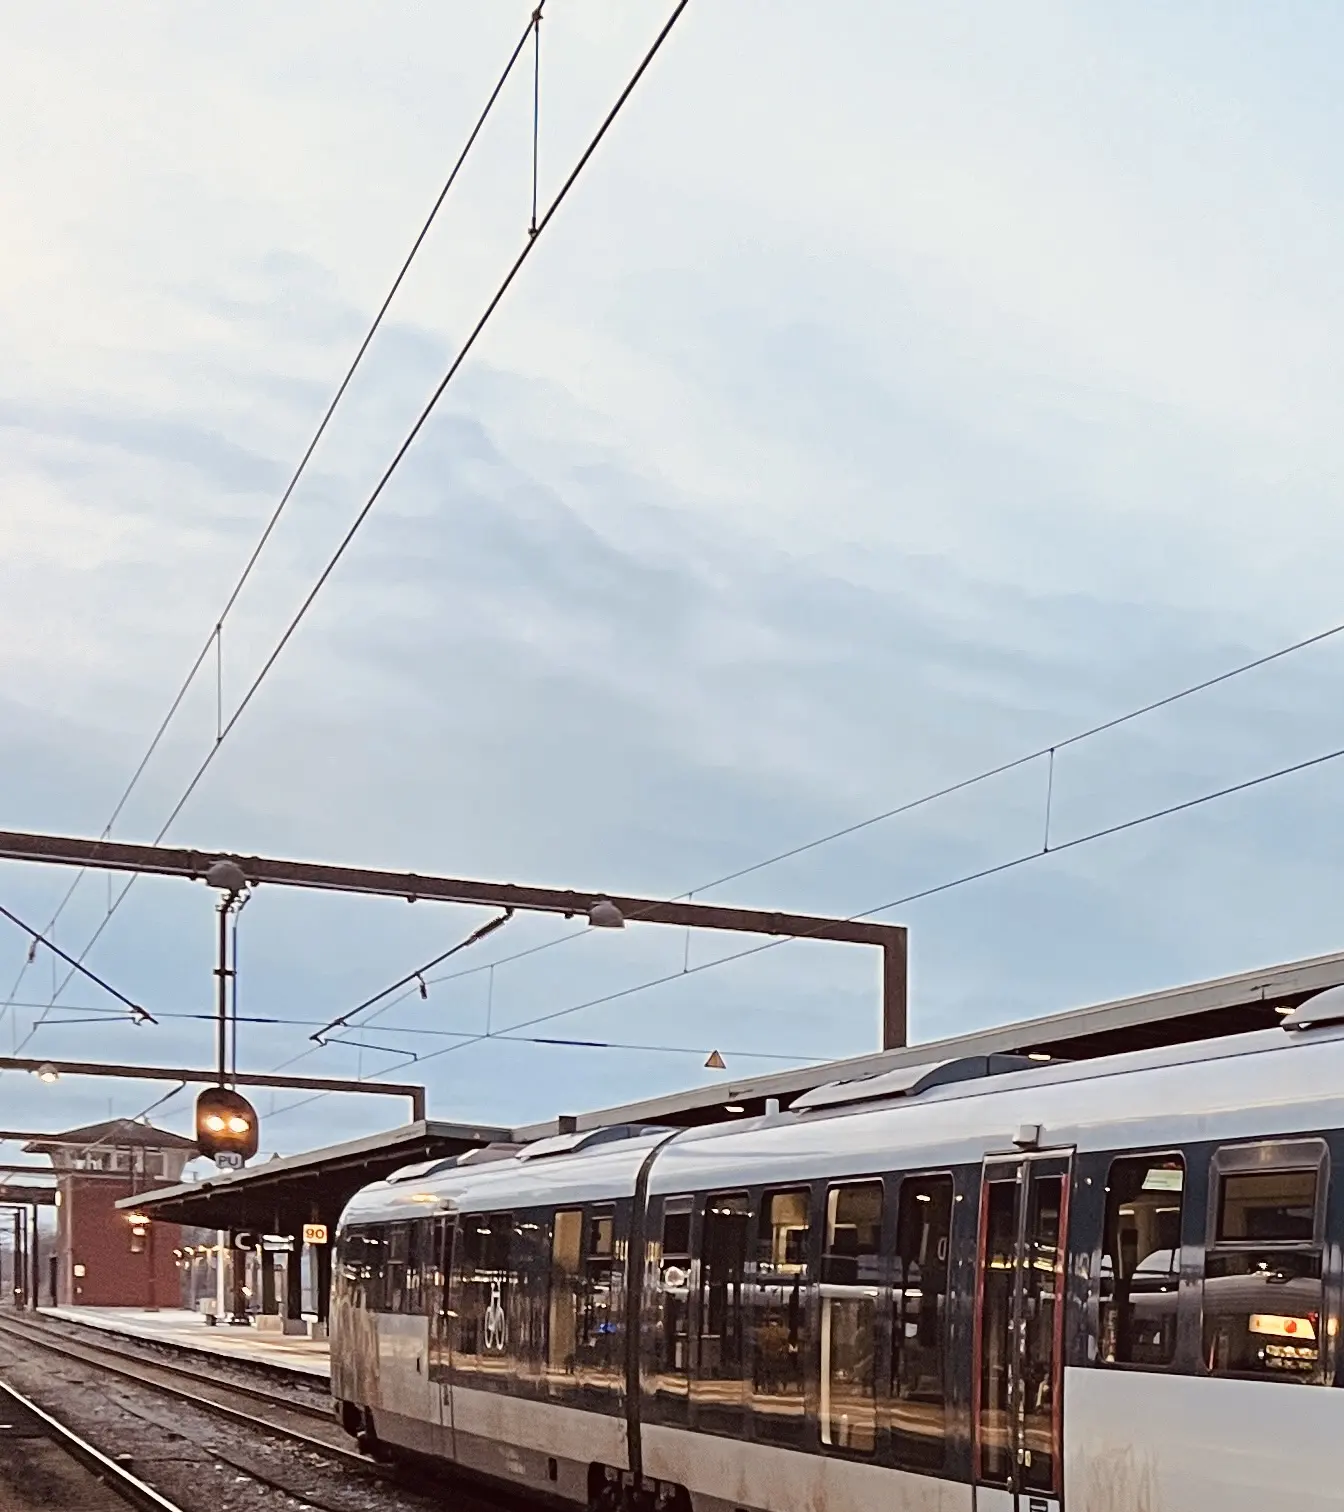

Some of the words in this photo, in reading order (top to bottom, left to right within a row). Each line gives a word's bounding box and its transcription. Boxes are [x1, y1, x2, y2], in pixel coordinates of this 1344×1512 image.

[218, 1156, 239, 1167] PU
[305, 1228, 325, 1239] 90
[235, 1232, 252, 1251] C
